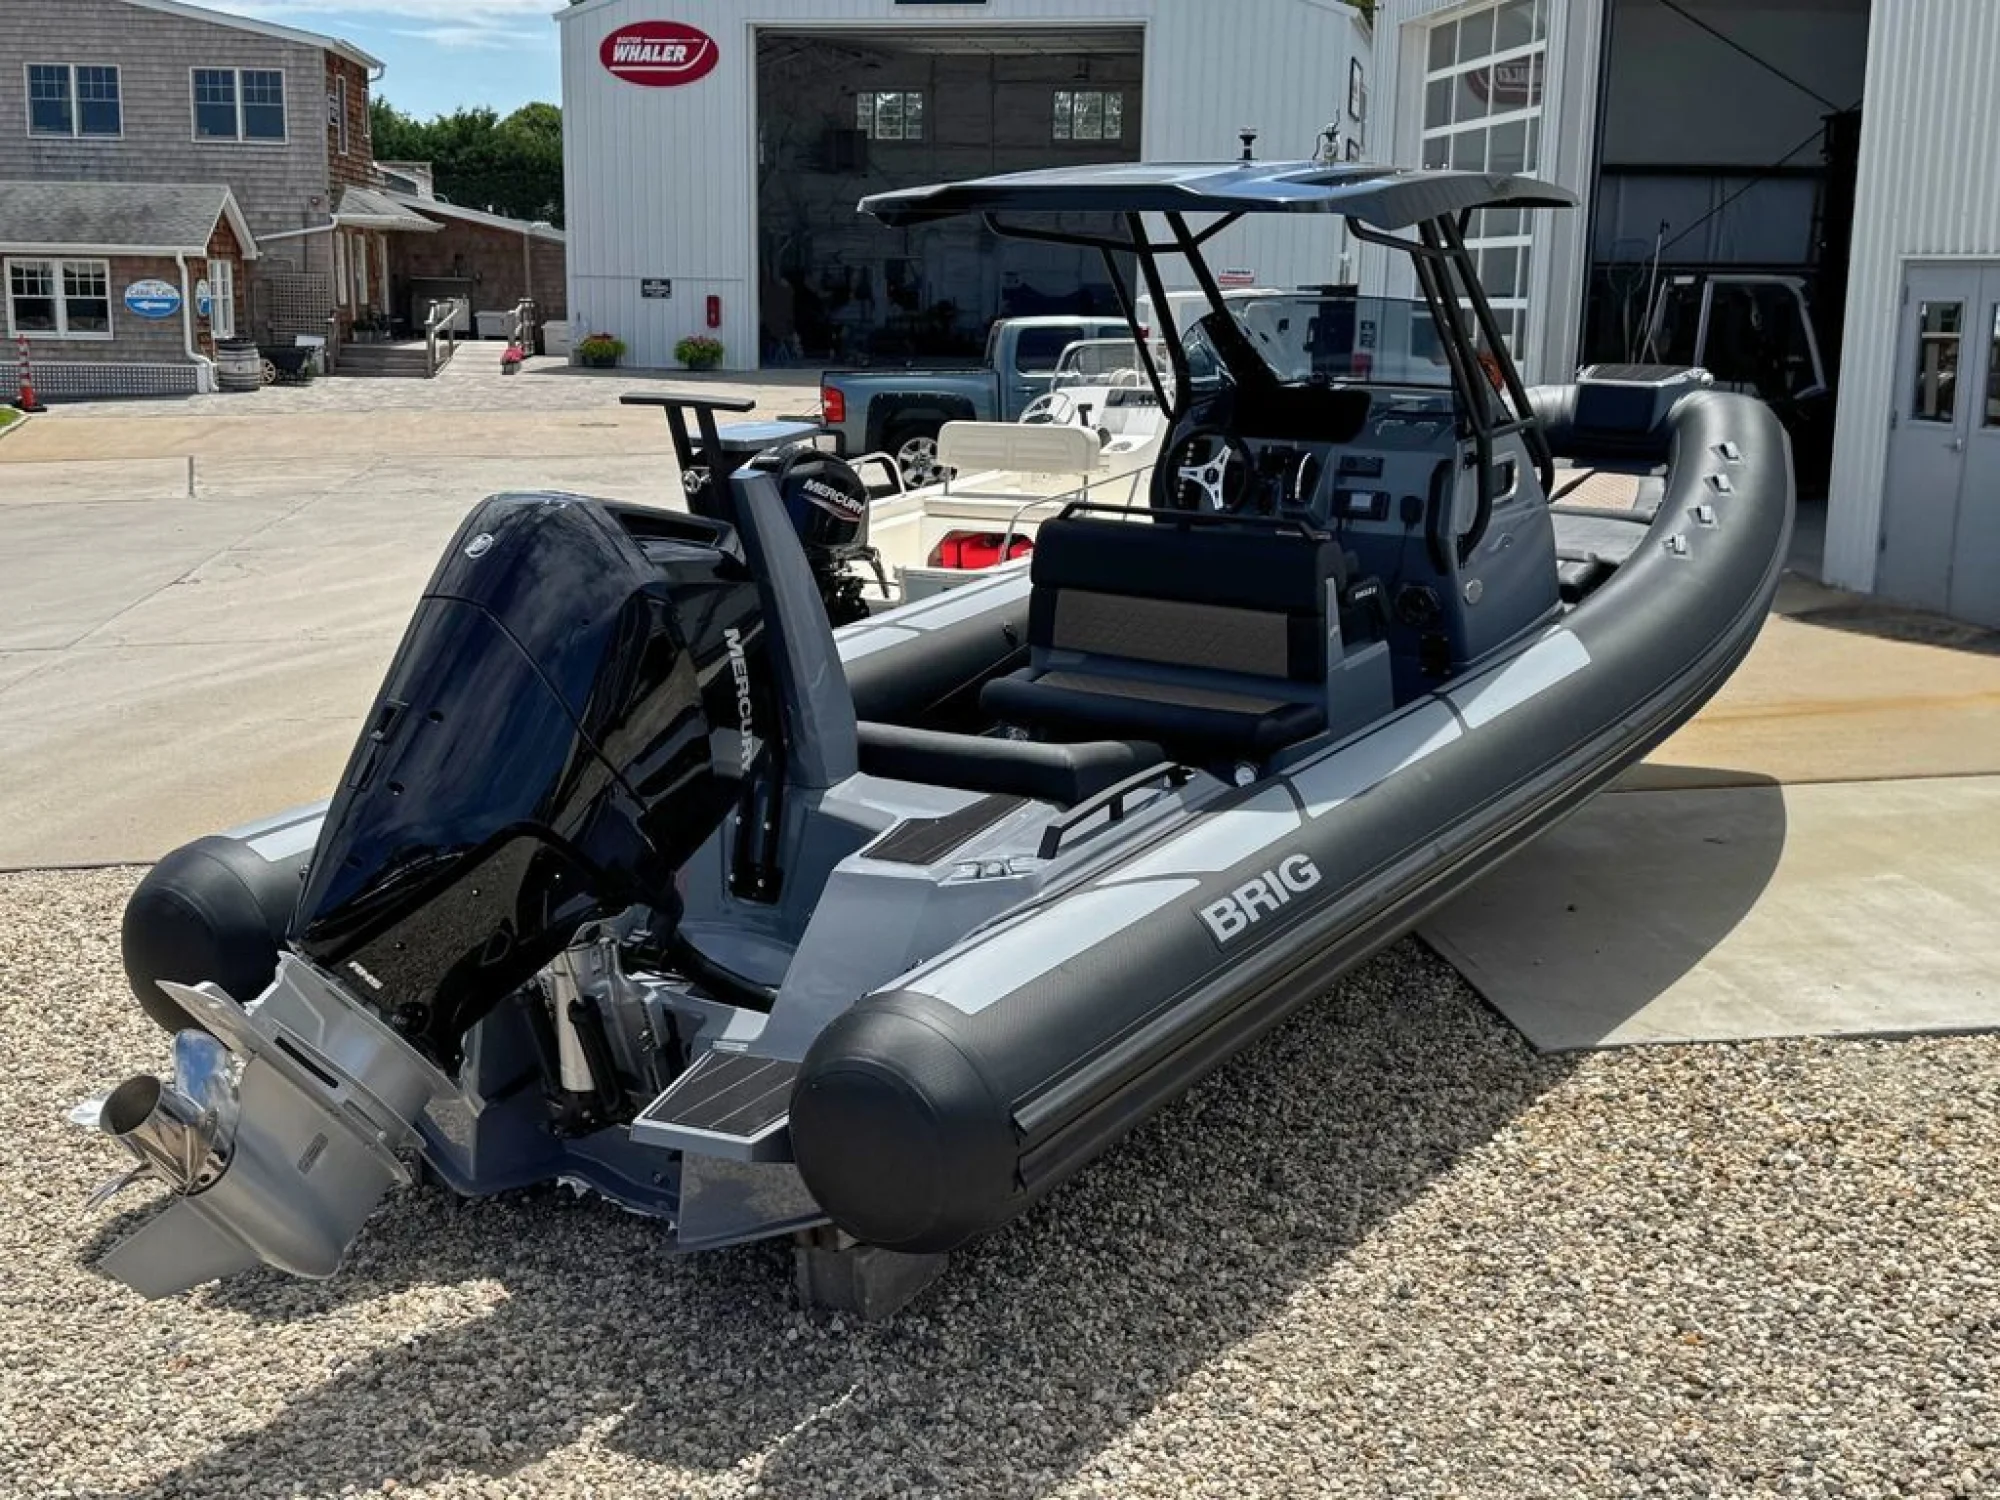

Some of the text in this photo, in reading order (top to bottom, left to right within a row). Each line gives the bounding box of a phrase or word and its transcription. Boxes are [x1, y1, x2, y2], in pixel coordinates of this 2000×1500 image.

[612, 44, 688, 62] WHALER
[803, 478, 866, 515] MERCURY
[724, 628, 753, 771] MERCURY
[1200, 854, 1322, 942] BRIG
